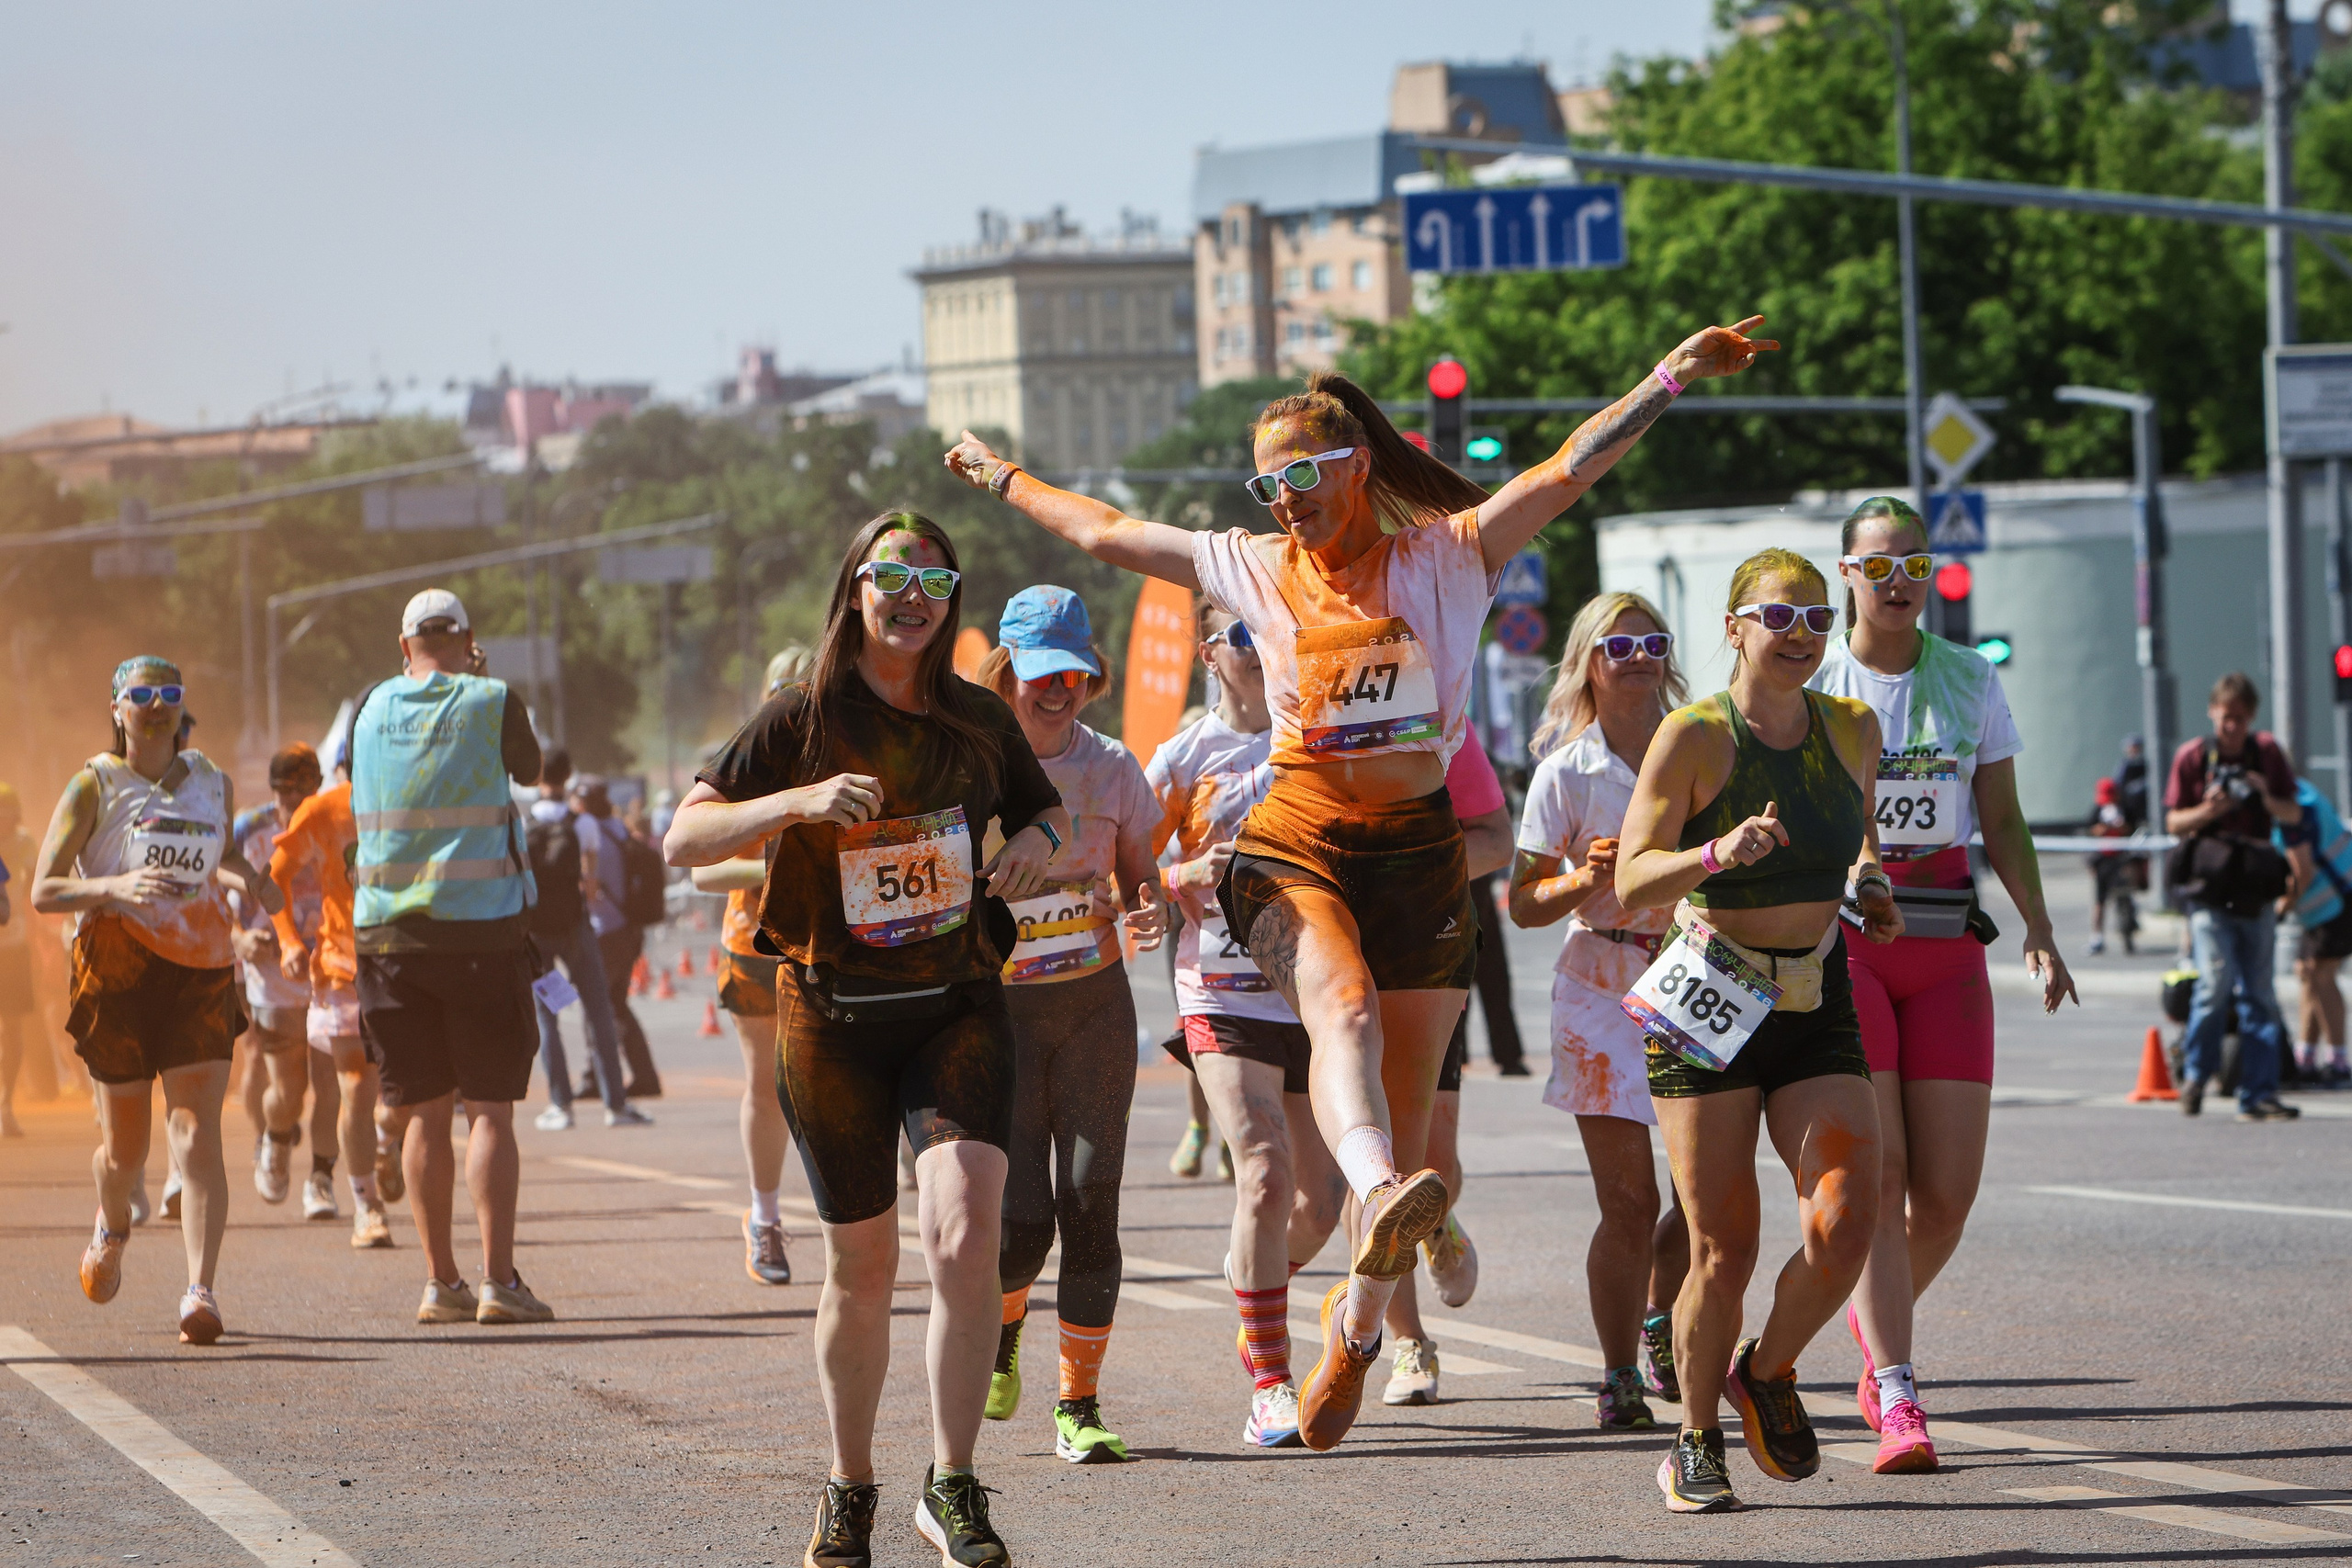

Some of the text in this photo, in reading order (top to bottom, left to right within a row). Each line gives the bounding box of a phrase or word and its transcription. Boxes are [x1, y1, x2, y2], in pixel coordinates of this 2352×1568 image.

[1329, 662, 1399, 706] 447
[1905, 773, 1955, 782] 2026
[1874, 796, 1936, 829] 493
[916, 824, 967, 843] 2026
[144, 843, 204, 873] 8046
[876, 857, 938, 903] 561
[1436, 931, 1462, 940] DEMIX
[1658, 963, 1743, 1035] 8185
[1725, 970, 1774, 1009] 2026
